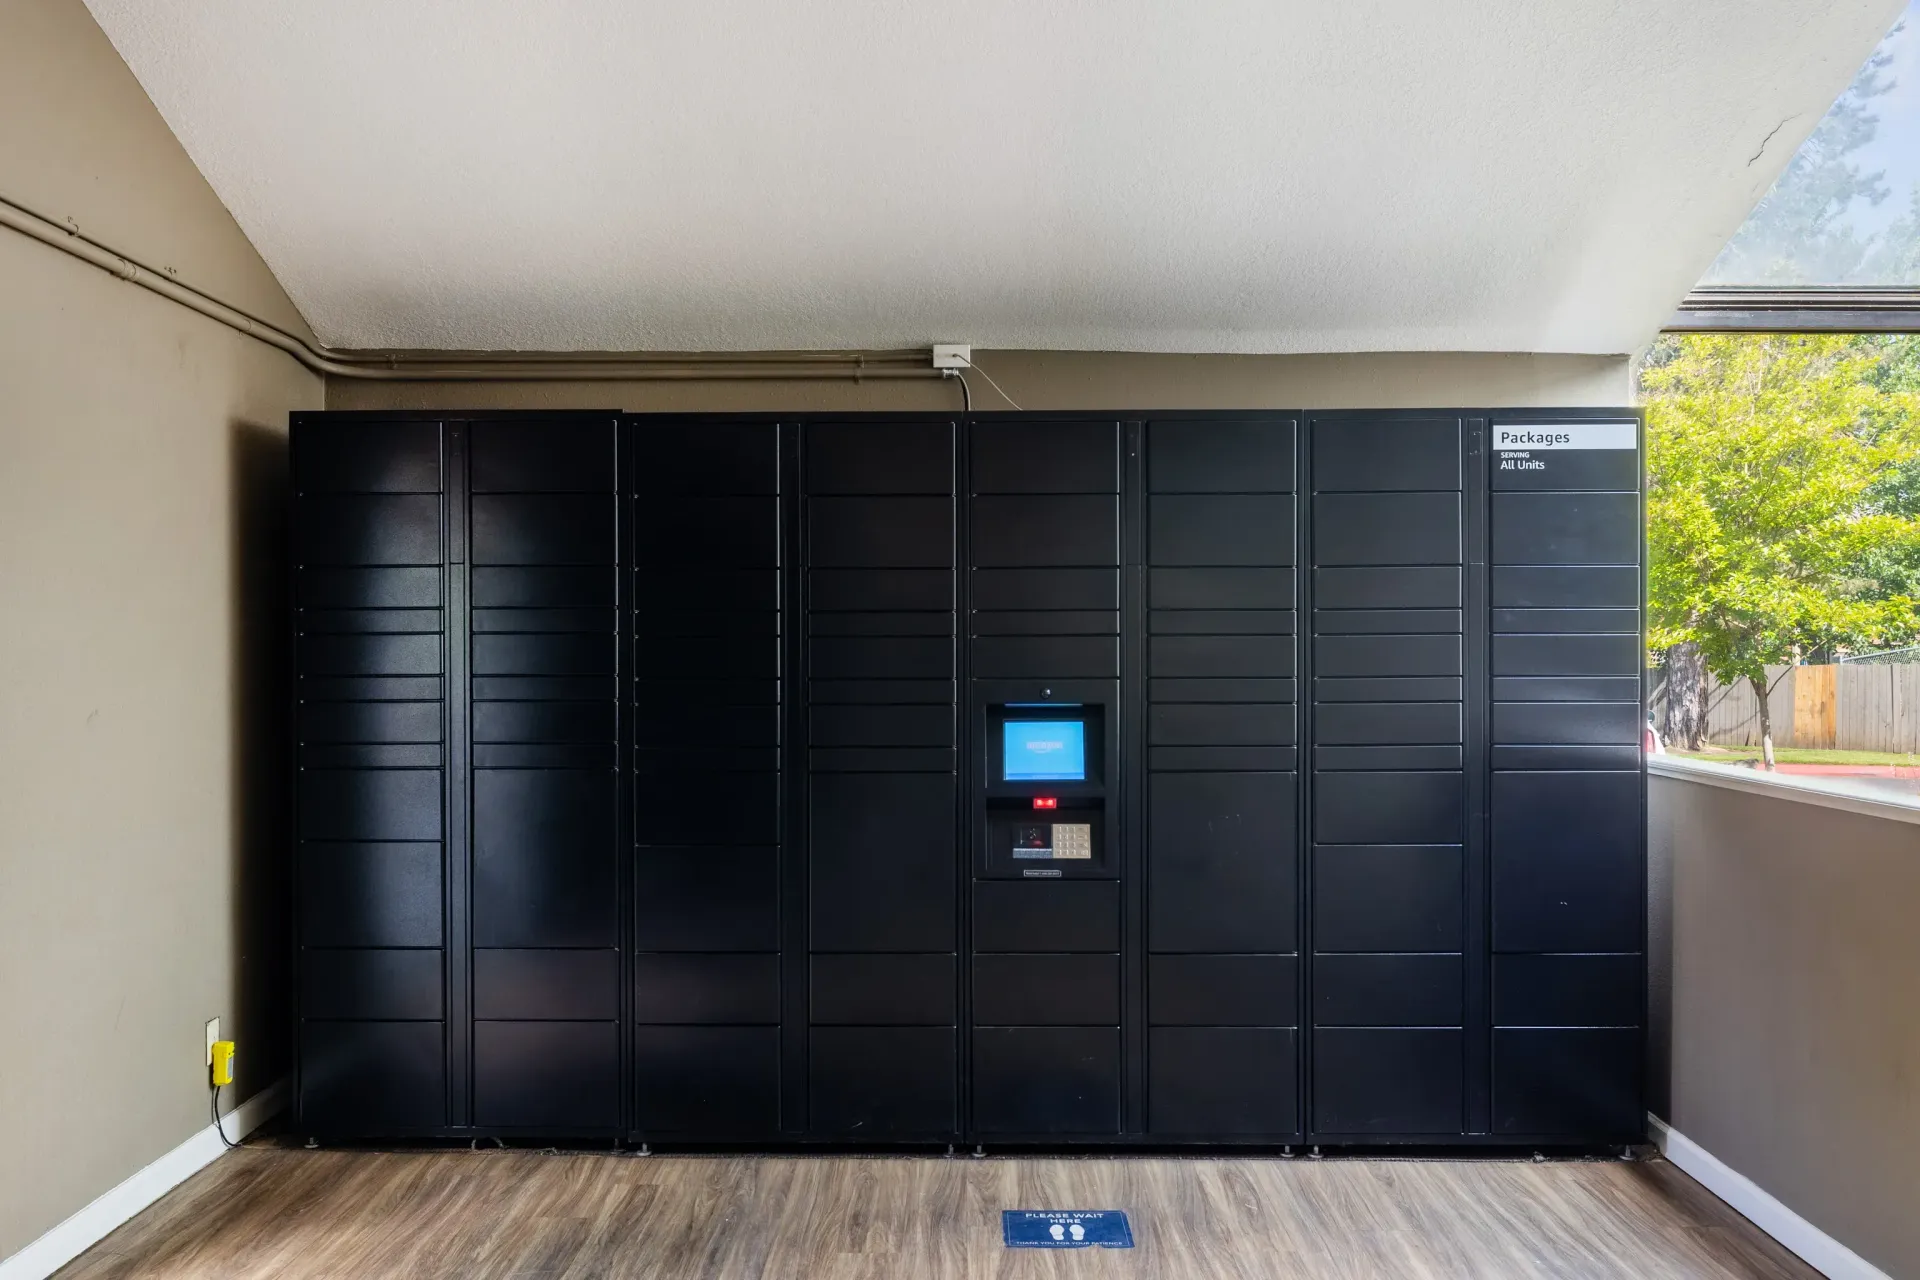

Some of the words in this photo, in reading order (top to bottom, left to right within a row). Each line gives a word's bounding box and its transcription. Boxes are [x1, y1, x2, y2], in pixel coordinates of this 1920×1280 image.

[1501, 431, 1570, 446] Packages
[1500, 460, 1515, 470] All
[1517, 460, 1545, 470] Units
